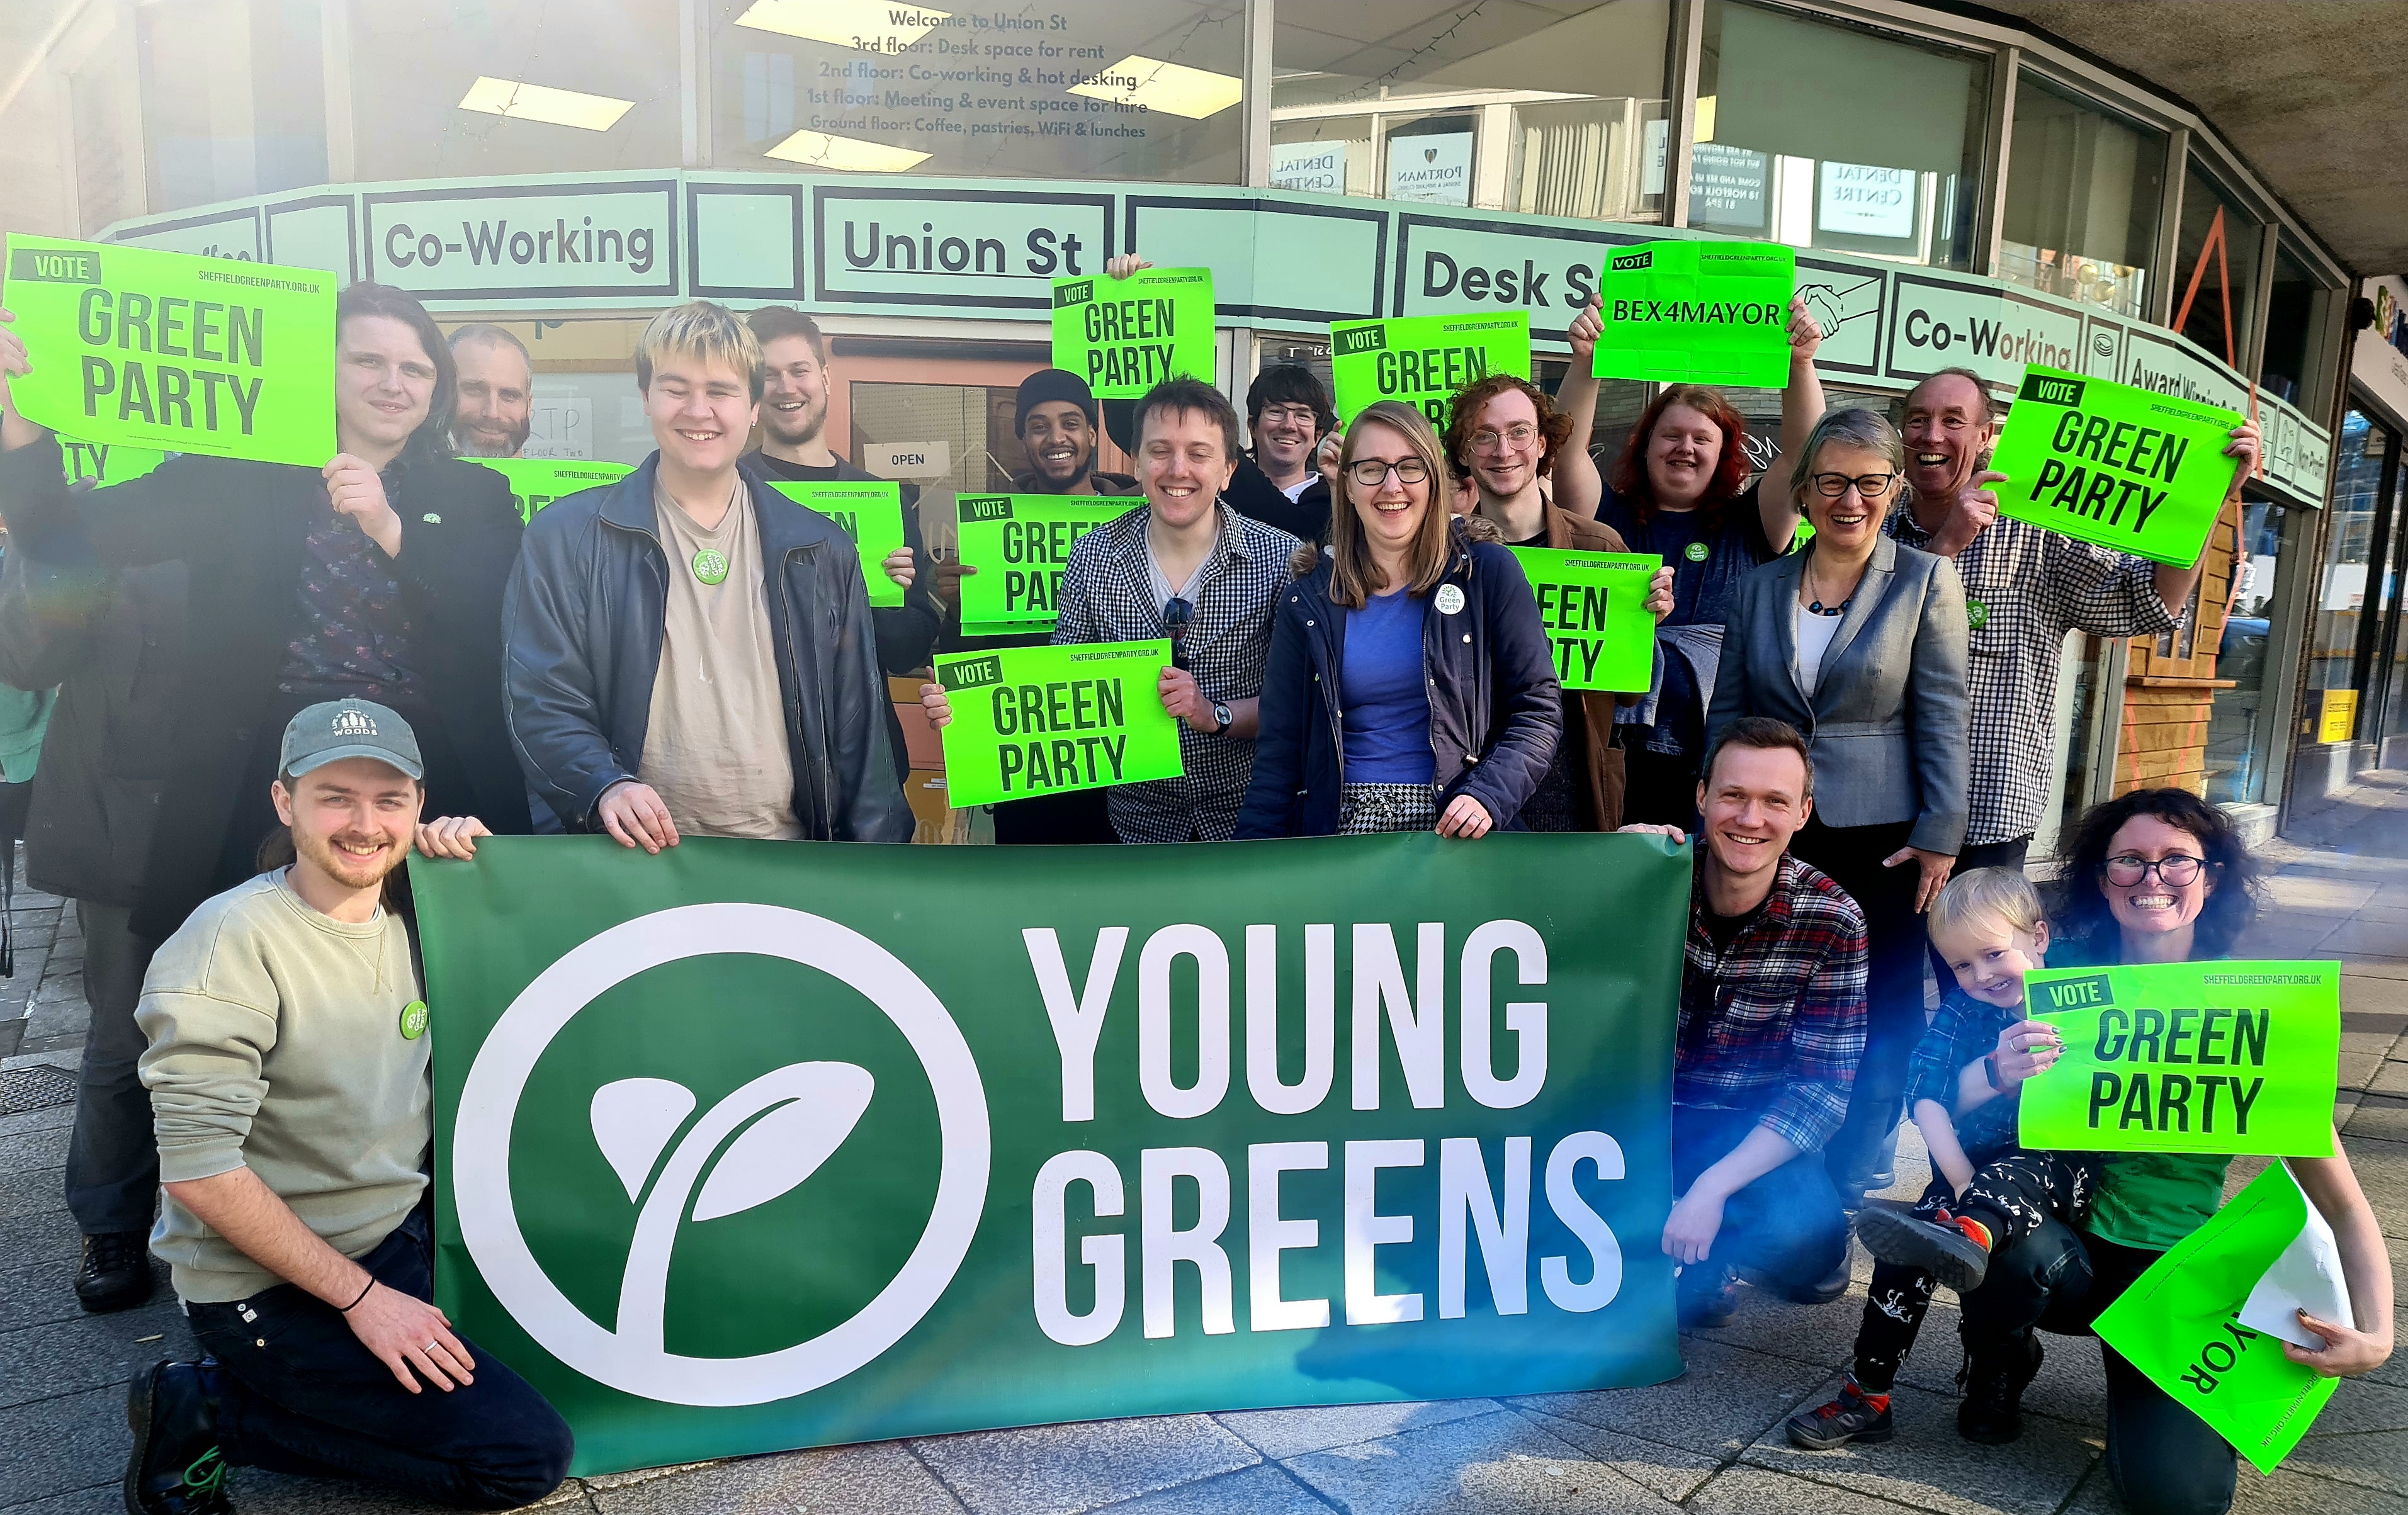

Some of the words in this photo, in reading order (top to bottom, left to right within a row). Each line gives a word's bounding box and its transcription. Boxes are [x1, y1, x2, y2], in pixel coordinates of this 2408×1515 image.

[888, 9, 967, 27] Welcome
[971, 14, 989, 28] to
[993, 13, 1044, 30] Union
[1049, 14, 1067, 31] St
[852, 36, 881, 52] 3rd
[886, 37, 933, 54] floor:
[938, 38, 978, 55] Desk
[984, 44, 1033, 60] space
[1038, 40, 1063, 57] for
[1069, 45, 1105, 59] rent
[819, 61, 852, 78] 2nd
[857, 62, 904, 79] floor:
[908, 64, 1013, 87] Co-working
[1018, 67, 1033, 84] &
[1037, 67, 1065, 85] hot
[1070, 69, 1137, 91] desking
[808, 88, 829, 104] 1st
[834, 88, 879, 106] floor:
[885, 90, 954, 112] Meeting
[959, 92, 973, 108] &
[978, 96, 1026, 110] event
[1029, 99, 1079, 115] space
[1084, 97, 1109, 113] for
[1114, 97, 1148, 113] hire
[810, 115, 867, 130] Ground
[871, 116, 910, 131] floor:
[914, 118, 967, 135] Coffee,
[971, 120, 1034, 137] pastries,
[1037, 121, 1070, 136] WiFi
[1075, 122, 1087, 137] &
[1090, 122, 1145, 138] lunches
[385, 215, 655, 274] Co-Working
[845, 222, 1006, 273] Union
[1026, 228, 1083, 276] St
[33, 254, 89, 279] VOTE
[1614, 256, 1650, 271] VOTE
[198, 269, 320, 295] SHEFFIELDGREENPARTY.ORG.UK
[1423, 251, 1551, 307] Desk
[1064, 284, 1088, 303] VOTE
[1084, 298, 1175, 344] GREEN
[1613, 300, 1780, 326] BEX4MAYOR
[77, 288, 264, 367] GREEN
[1346, 329, 1379, 350] VOTE
[1905, 308, 2072, 370] Co-Working
[1088, 343, 1175, 387] PARTY
[1377, 346, 1487, 395] GREEN
[81, 355, 264, 436] PARTY
[2038, 380, 2077, 403] VOTE
[891, 454, 925, 465] OPEN
[2052, 410, 2190, 484] GREEN
[972, 500, 1006, 517] VOTE
[2029, 458, 2169, 534] PARTY
[1564, 559, 1650, 572] SHEFFIELDGREENPARTY.ORG.UK
[1440, 603, 1459, 612] Party
[1537, 583, 1608, 632] EEN
[1070, 648, 1159, 662] SHEFFIELDGREENPARTY.ORG.UK
[953, 661, 995, 685] VOTE
[992, 678, 1125, 736] GREEN
[998, 734, 1126, 792] PARTY
[2203, 974, 2322, 985] SHEFFIELDGREENPARTY.ORG.UK
[2049, 981, 2102, 1008] VOTE
[1021, 919, 1548, 1122] YOUNG
[2093, 1008, 2271, 1066] GREEN
[2088, 1072, 2264, 1135] PARTY
[1031, 1130, 1626, 1346] GREENS
